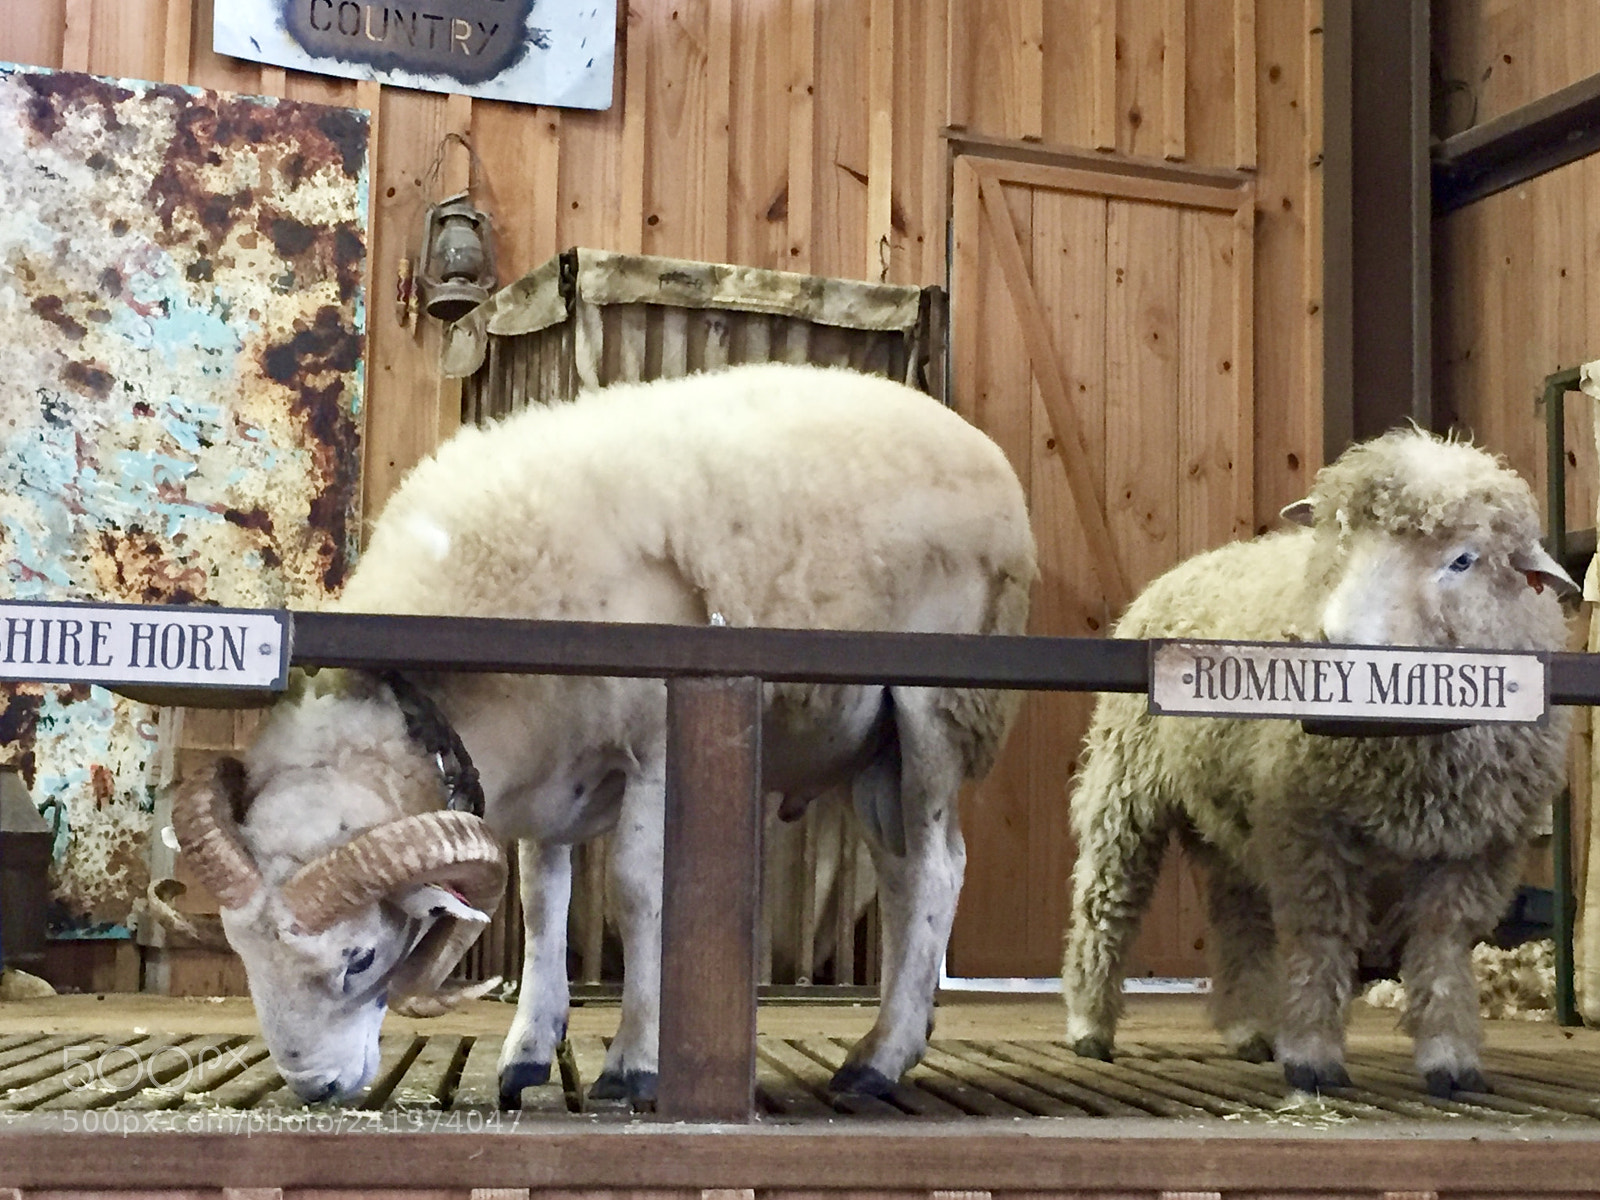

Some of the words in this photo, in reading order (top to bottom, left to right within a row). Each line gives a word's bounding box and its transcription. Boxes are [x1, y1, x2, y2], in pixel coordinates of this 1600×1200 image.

[310, 0, 499, 55] COUNTRY
[0, 617, 114, 667] HIRE
[128, 622, 248, 671] HORN
[1192, 655, 1355, 704] ROMNEY
[1367, 662, 1508, 709] MARSH
